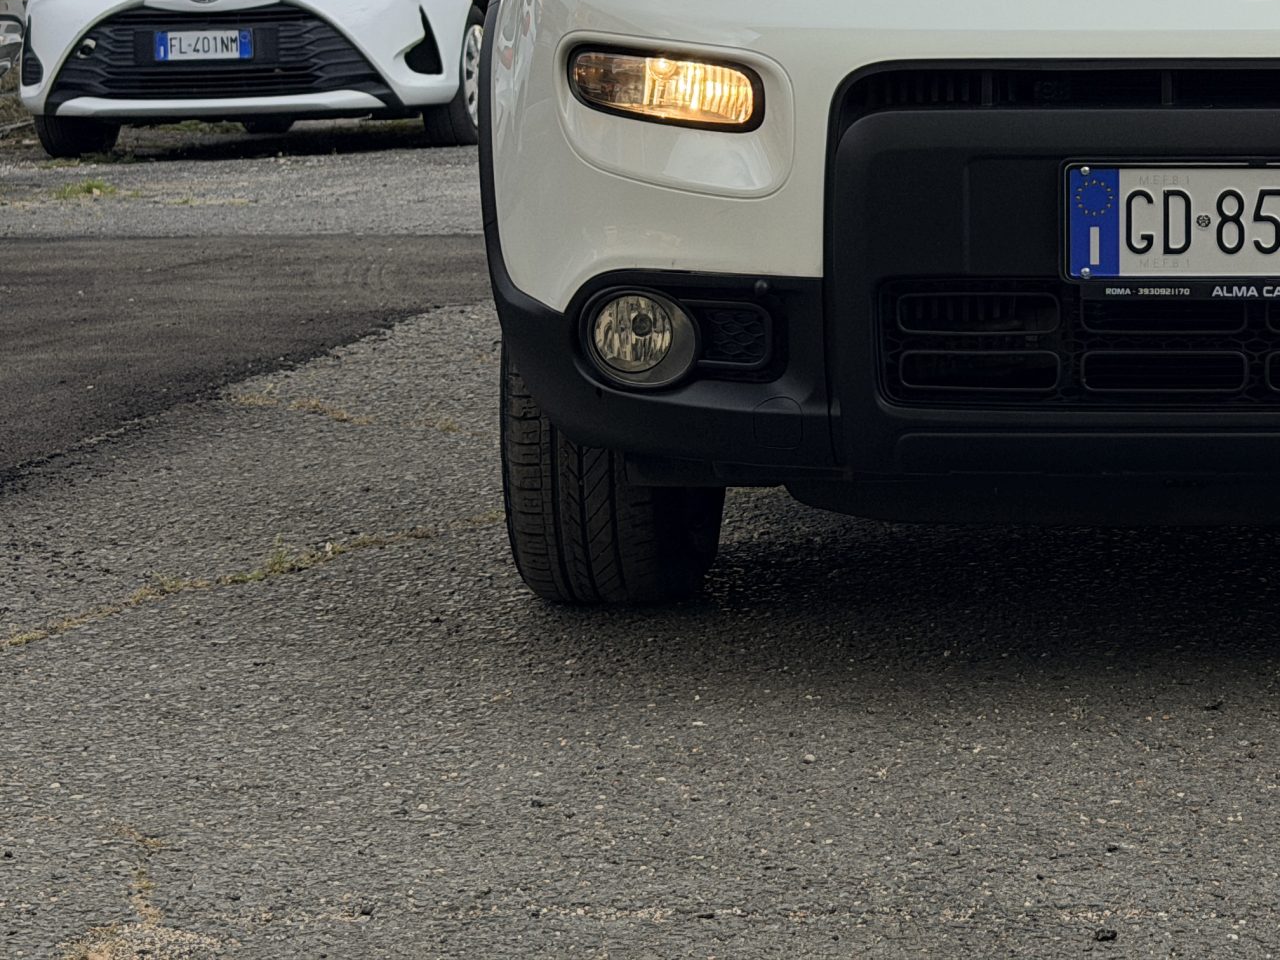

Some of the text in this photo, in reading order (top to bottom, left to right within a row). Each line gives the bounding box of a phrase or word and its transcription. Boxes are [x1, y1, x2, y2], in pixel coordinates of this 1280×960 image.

[1105, 287, 1131, 296] ROMA
[1137, 287, 1191, 296] 3930921170
[1211, 285, 1259, 298] ALMA
